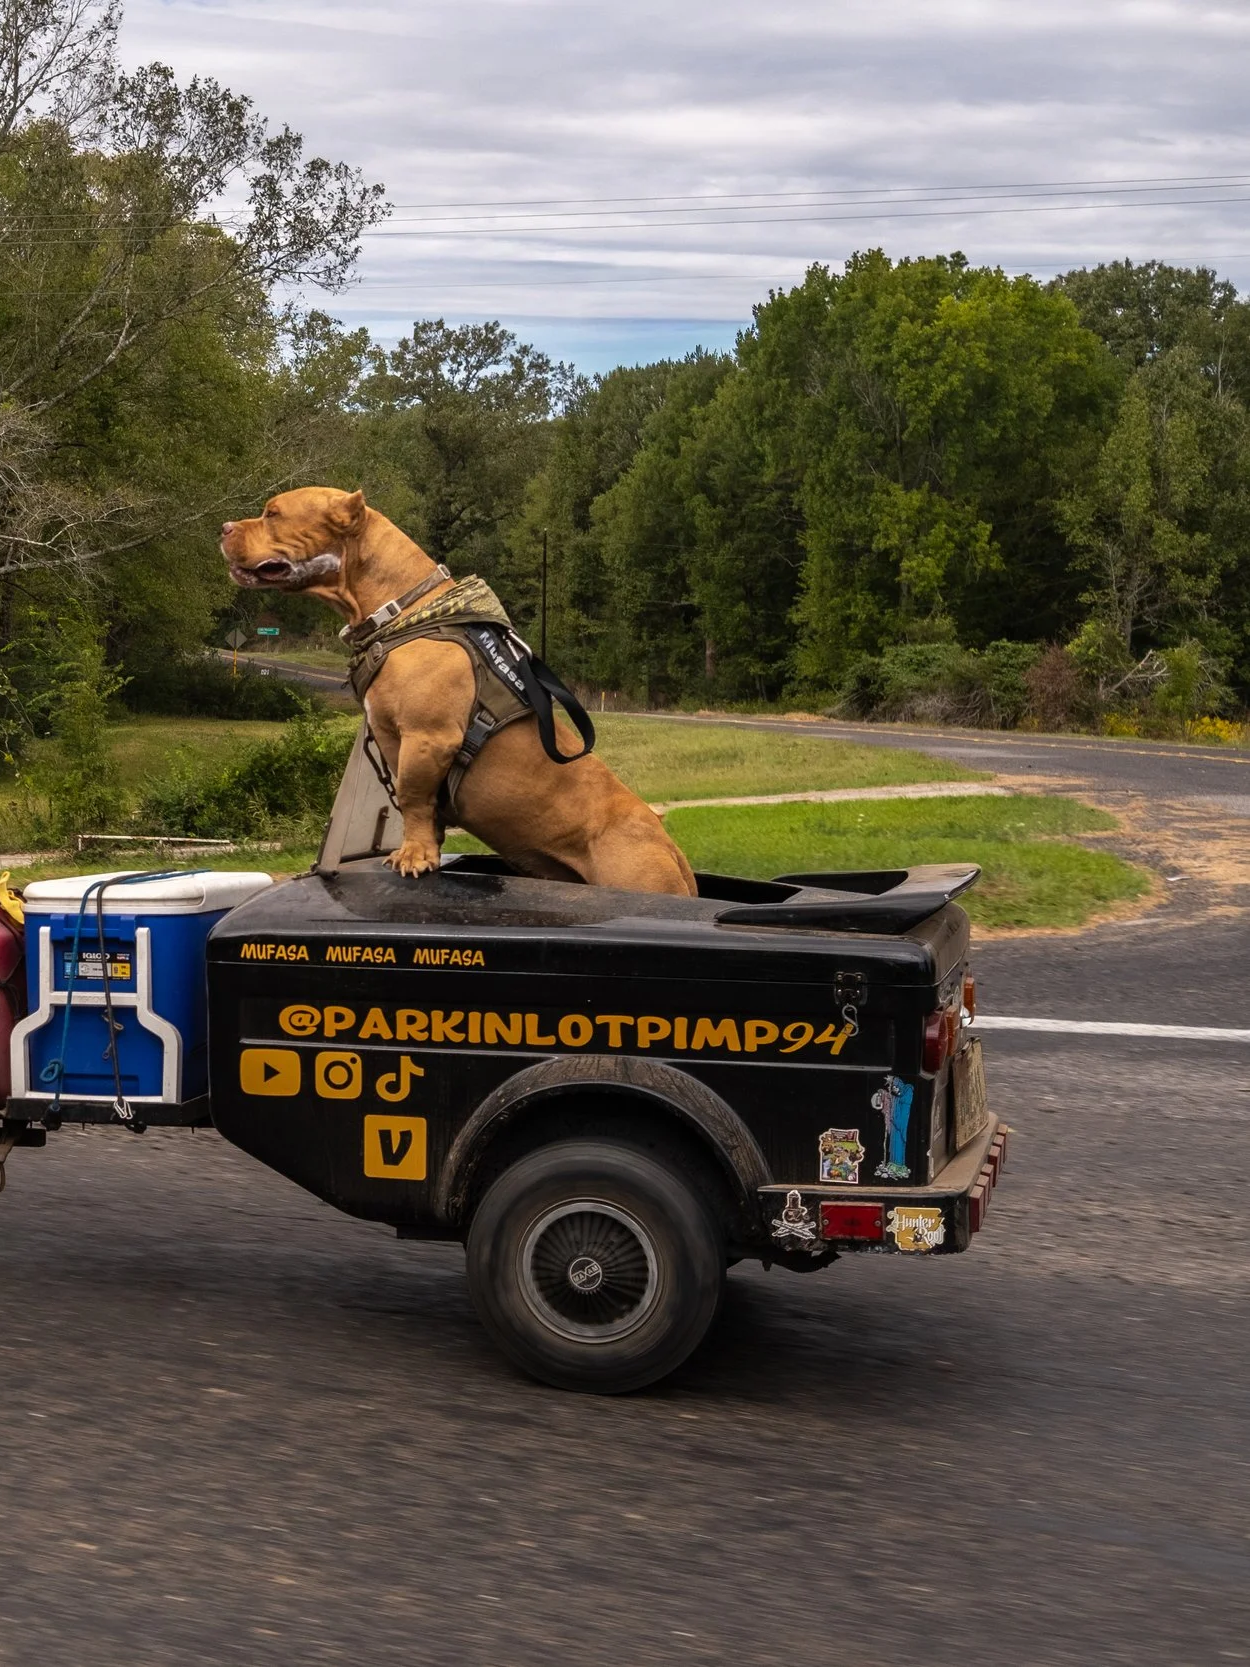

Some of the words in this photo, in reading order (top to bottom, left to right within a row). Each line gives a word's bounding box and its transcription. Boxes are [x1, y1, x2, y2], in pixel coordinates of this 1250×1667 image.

[479, 631, 526, 691] Mufasa
[241, 944, 309, 961] MUFASA
[326, 946, 396, 963] MUFASA
[413, 948, 485, 966] MUFASA
[278, 1004, 855, 1055] @PARKINLOTPIMP94
[886, 1211, 935, 1232] Hunter
